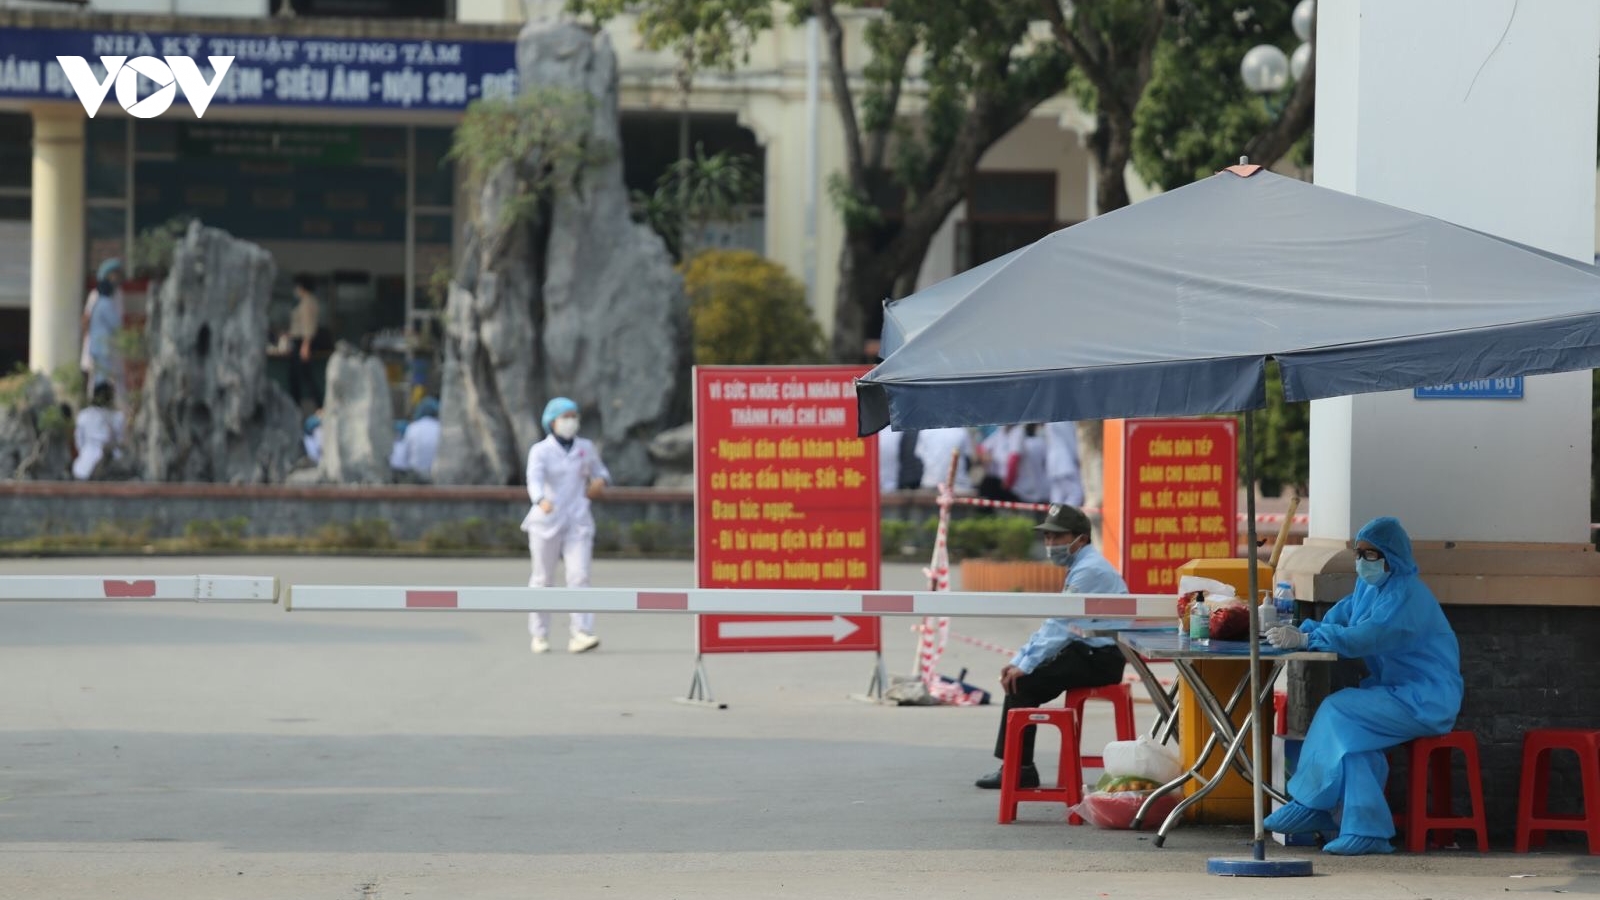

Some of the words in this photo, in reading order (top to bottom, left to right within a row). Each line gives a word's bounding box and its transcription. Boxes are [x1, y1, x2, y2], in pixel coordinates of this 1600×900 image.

[93, 33, 155, 56] NHÀ
[209, 37, 298, 63] THUẬT
[302, 40, 397, 63] TRUNG
[401, 40, 462, 64] TÂM
[276, 64, 328, 99] SIÊU
[331, 64, 370, 100] ÂM
[382, 66, 423, 107] NỘI
[427, 71, 467, 103] SOI
[709, 379, 721, 399] VÌ
[723, 379, 747, 399] SỨC
[782, 376, 805, 399] CỦA
[807, 379, 840, 398] NHÂN
[731, 406, 768, 426] THÀNH
[771, 403, 795, 425] PHỐ
[797, 405, 816, 425] CHÍ
[819, 407, 845, 425] LINH
[719, 438, 752, 461] Người
[754, 438, 776, 458] dân
[779, 436, 800, 458] đến
[802, 438, 834, 458] khám
[836, 437, 864, 461] bệnh
[1174, 437, 1193, 456] ĐÓN
[1195, 434, 1213, 456] TIẾP
[711, 469, 727, 489] có
[730, 469, 753, 489] các
[756, 465, 779, 489] dấu
[782, 468, 812, 492] hiệu:
[1140, 463, 1164, 482] DÀNH
[1165, 465, 1183, 482] CHO
[1184, 461, 1211, 482] NGƯỜI
[1213, 464, 1222, 485] BỊ
[1156, 486, 1176, 508] SỐT,
[1177, 485, 1199, 508] CHẢY
[1135, 517, 1153, 534] ĐAU
[751, 530, 778, 552] vùng
[781, 529, 807, 553] dịch
[847, 527, 866, 549] vui
[1131, 540, 1148, 559] KHÓ
[1168, 542, 1186, 559] ĐAU
[1204, 539, 1229, 558] NGƯỜI
[712, 560, 738, 583] lòng
[741, 560, 753, 580] đi
[755, 560, 781, 580] theo
[783, 558, 820, 582] hướng
[822, 558, 846, 579] mũi
[847, 557, 867, 579] tên
[1147, 566, 1159, 586] VÀ
[1160, 566, 1174, 586] CÓ
